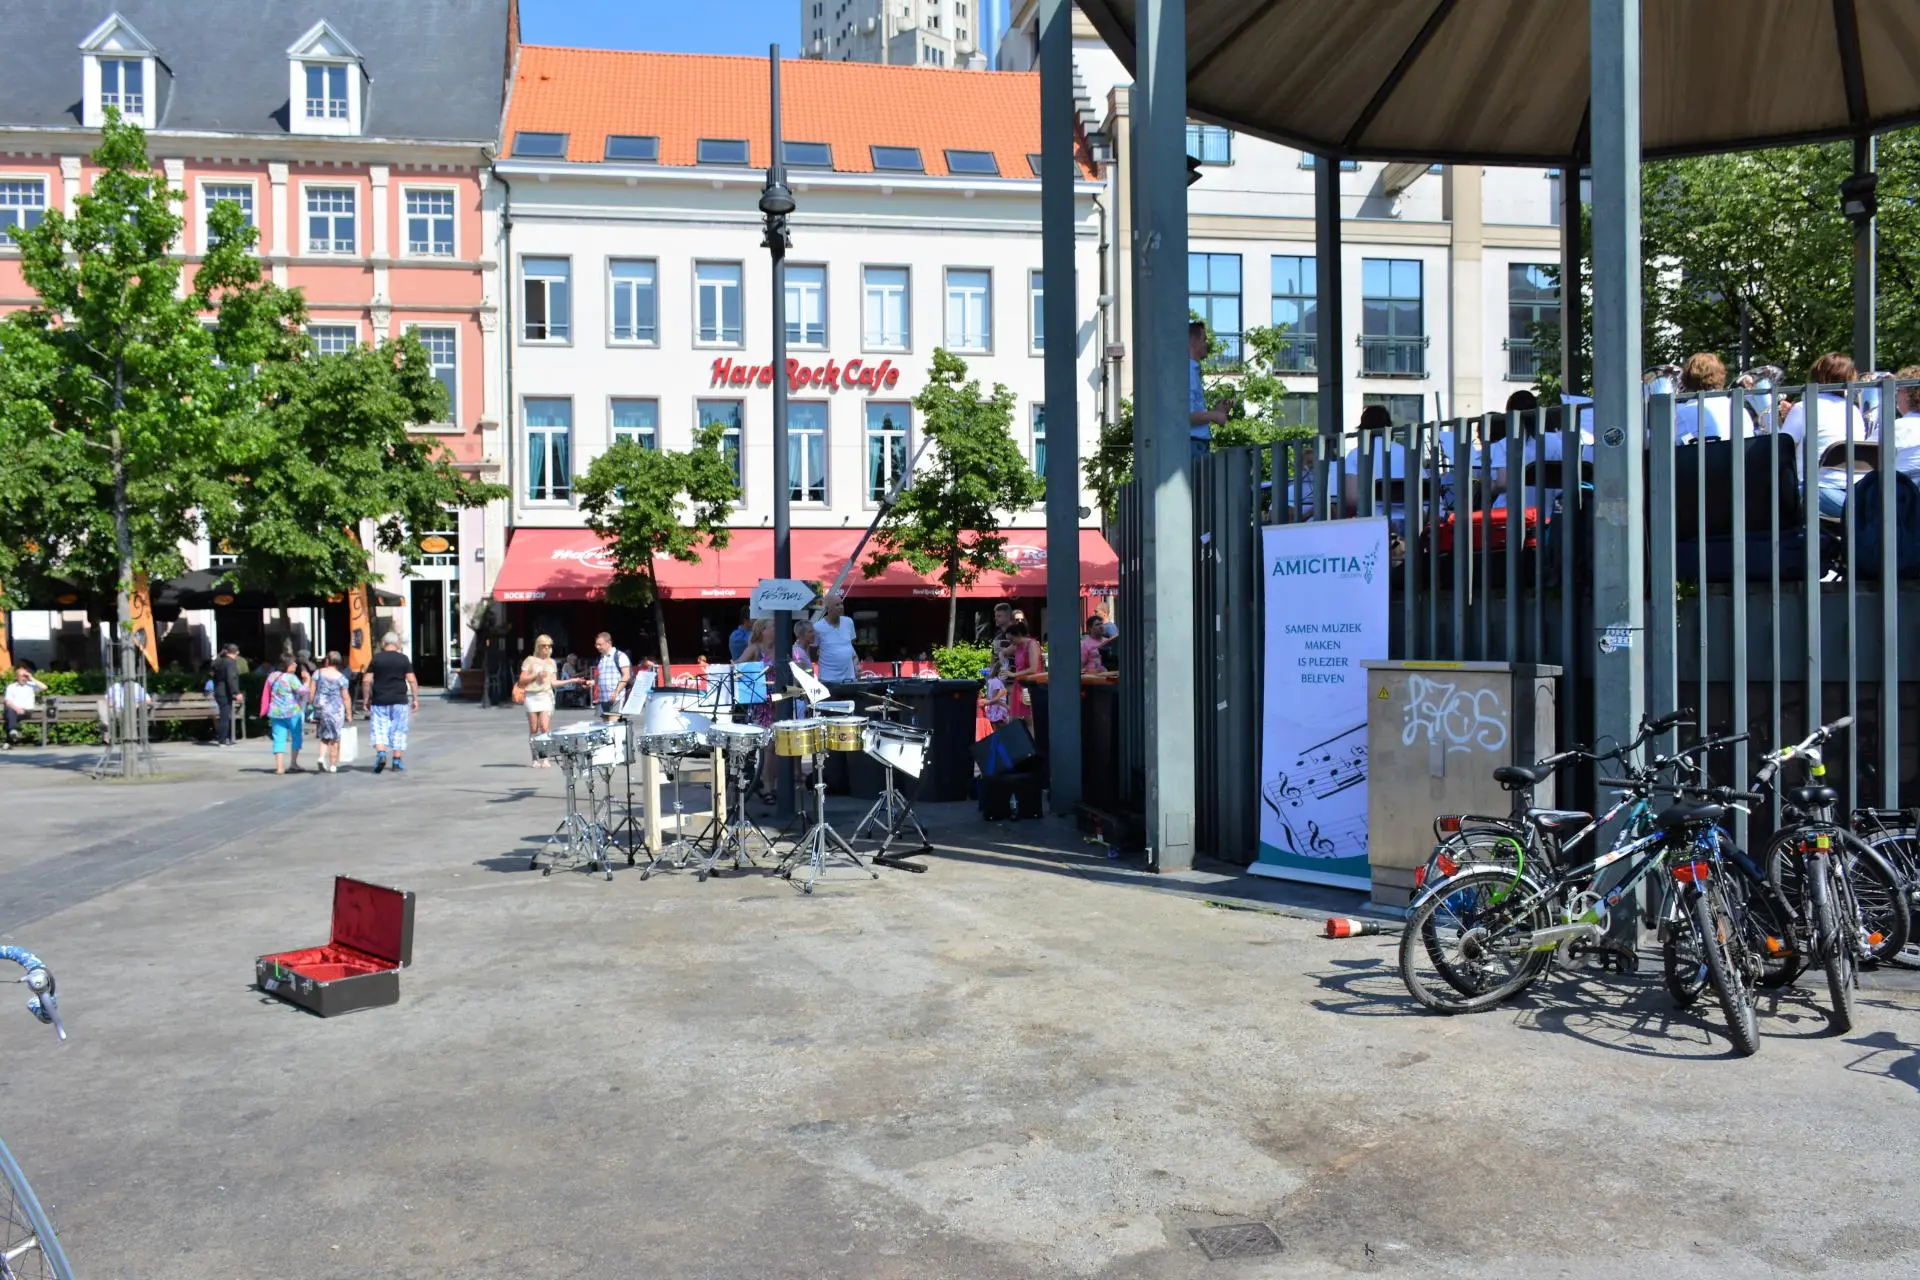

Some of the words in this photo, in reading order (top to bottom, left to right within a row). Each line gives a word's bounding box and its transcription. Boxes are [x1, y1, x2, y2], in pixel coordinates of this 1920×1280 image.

[713, 357, 774, 386] Hard
[784, 357, 840, 392] Rock
[843, 358, 900, 393] Cafe
[1272, 556, 1361, 577] AMICITIA
[525, 591, 546, 599] SHOP
[1285, 624, 1319, 634] SAMEN
[1321, 623, 1362, 633] MUZIEK
[1304, 640, 1341, 650] MAKEN
[1298, 658, 1306, 667] IS
[1308, 657, 1348, 667] PLEZIER
[1301, 673, 1345, 684] BELEVEN
